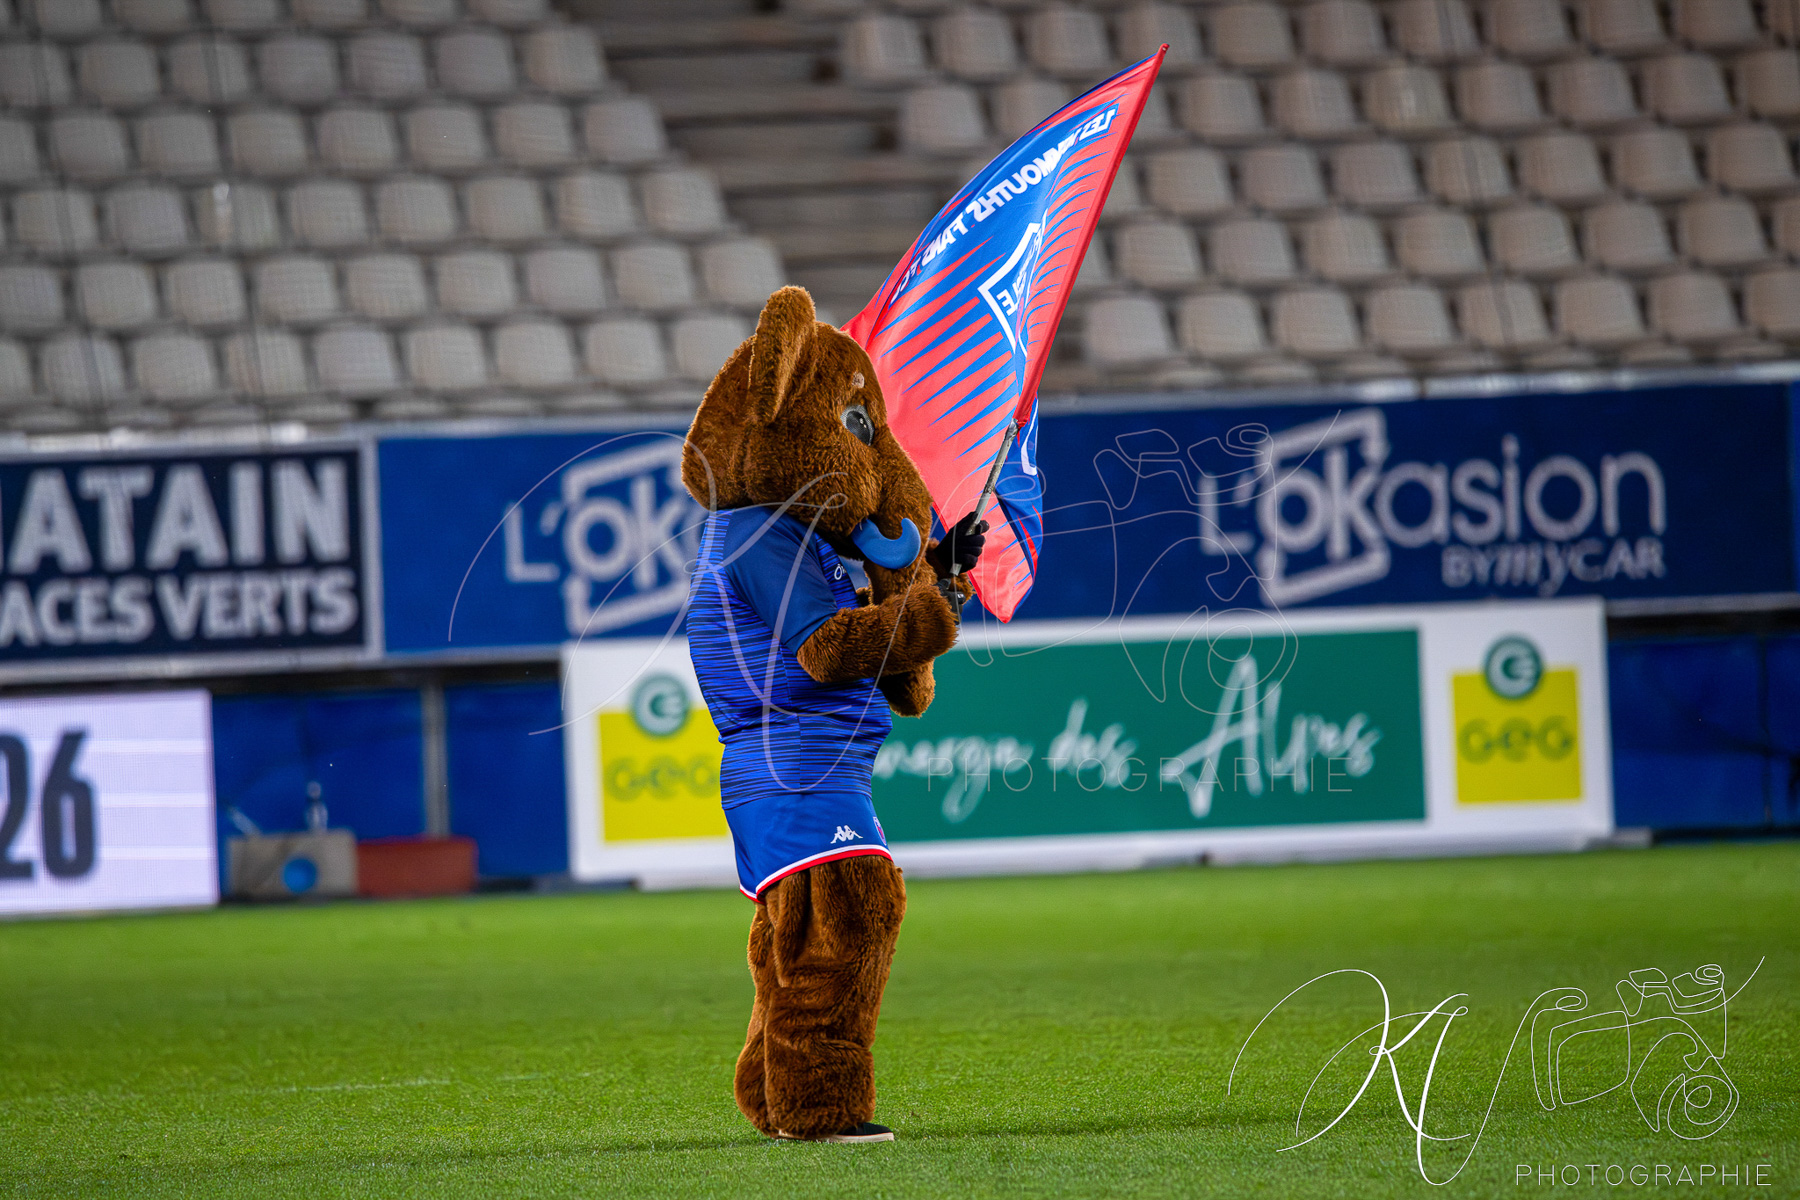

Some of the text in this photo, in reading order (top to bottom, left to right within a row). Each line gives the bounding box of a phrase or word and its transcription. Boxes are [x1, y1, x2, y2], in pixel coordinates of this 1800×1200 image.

[0, 458, 350, 573] ATAIN
[155, 566, 358, 641] VERTS
[1158, 653, 1384, 819] Alpes
